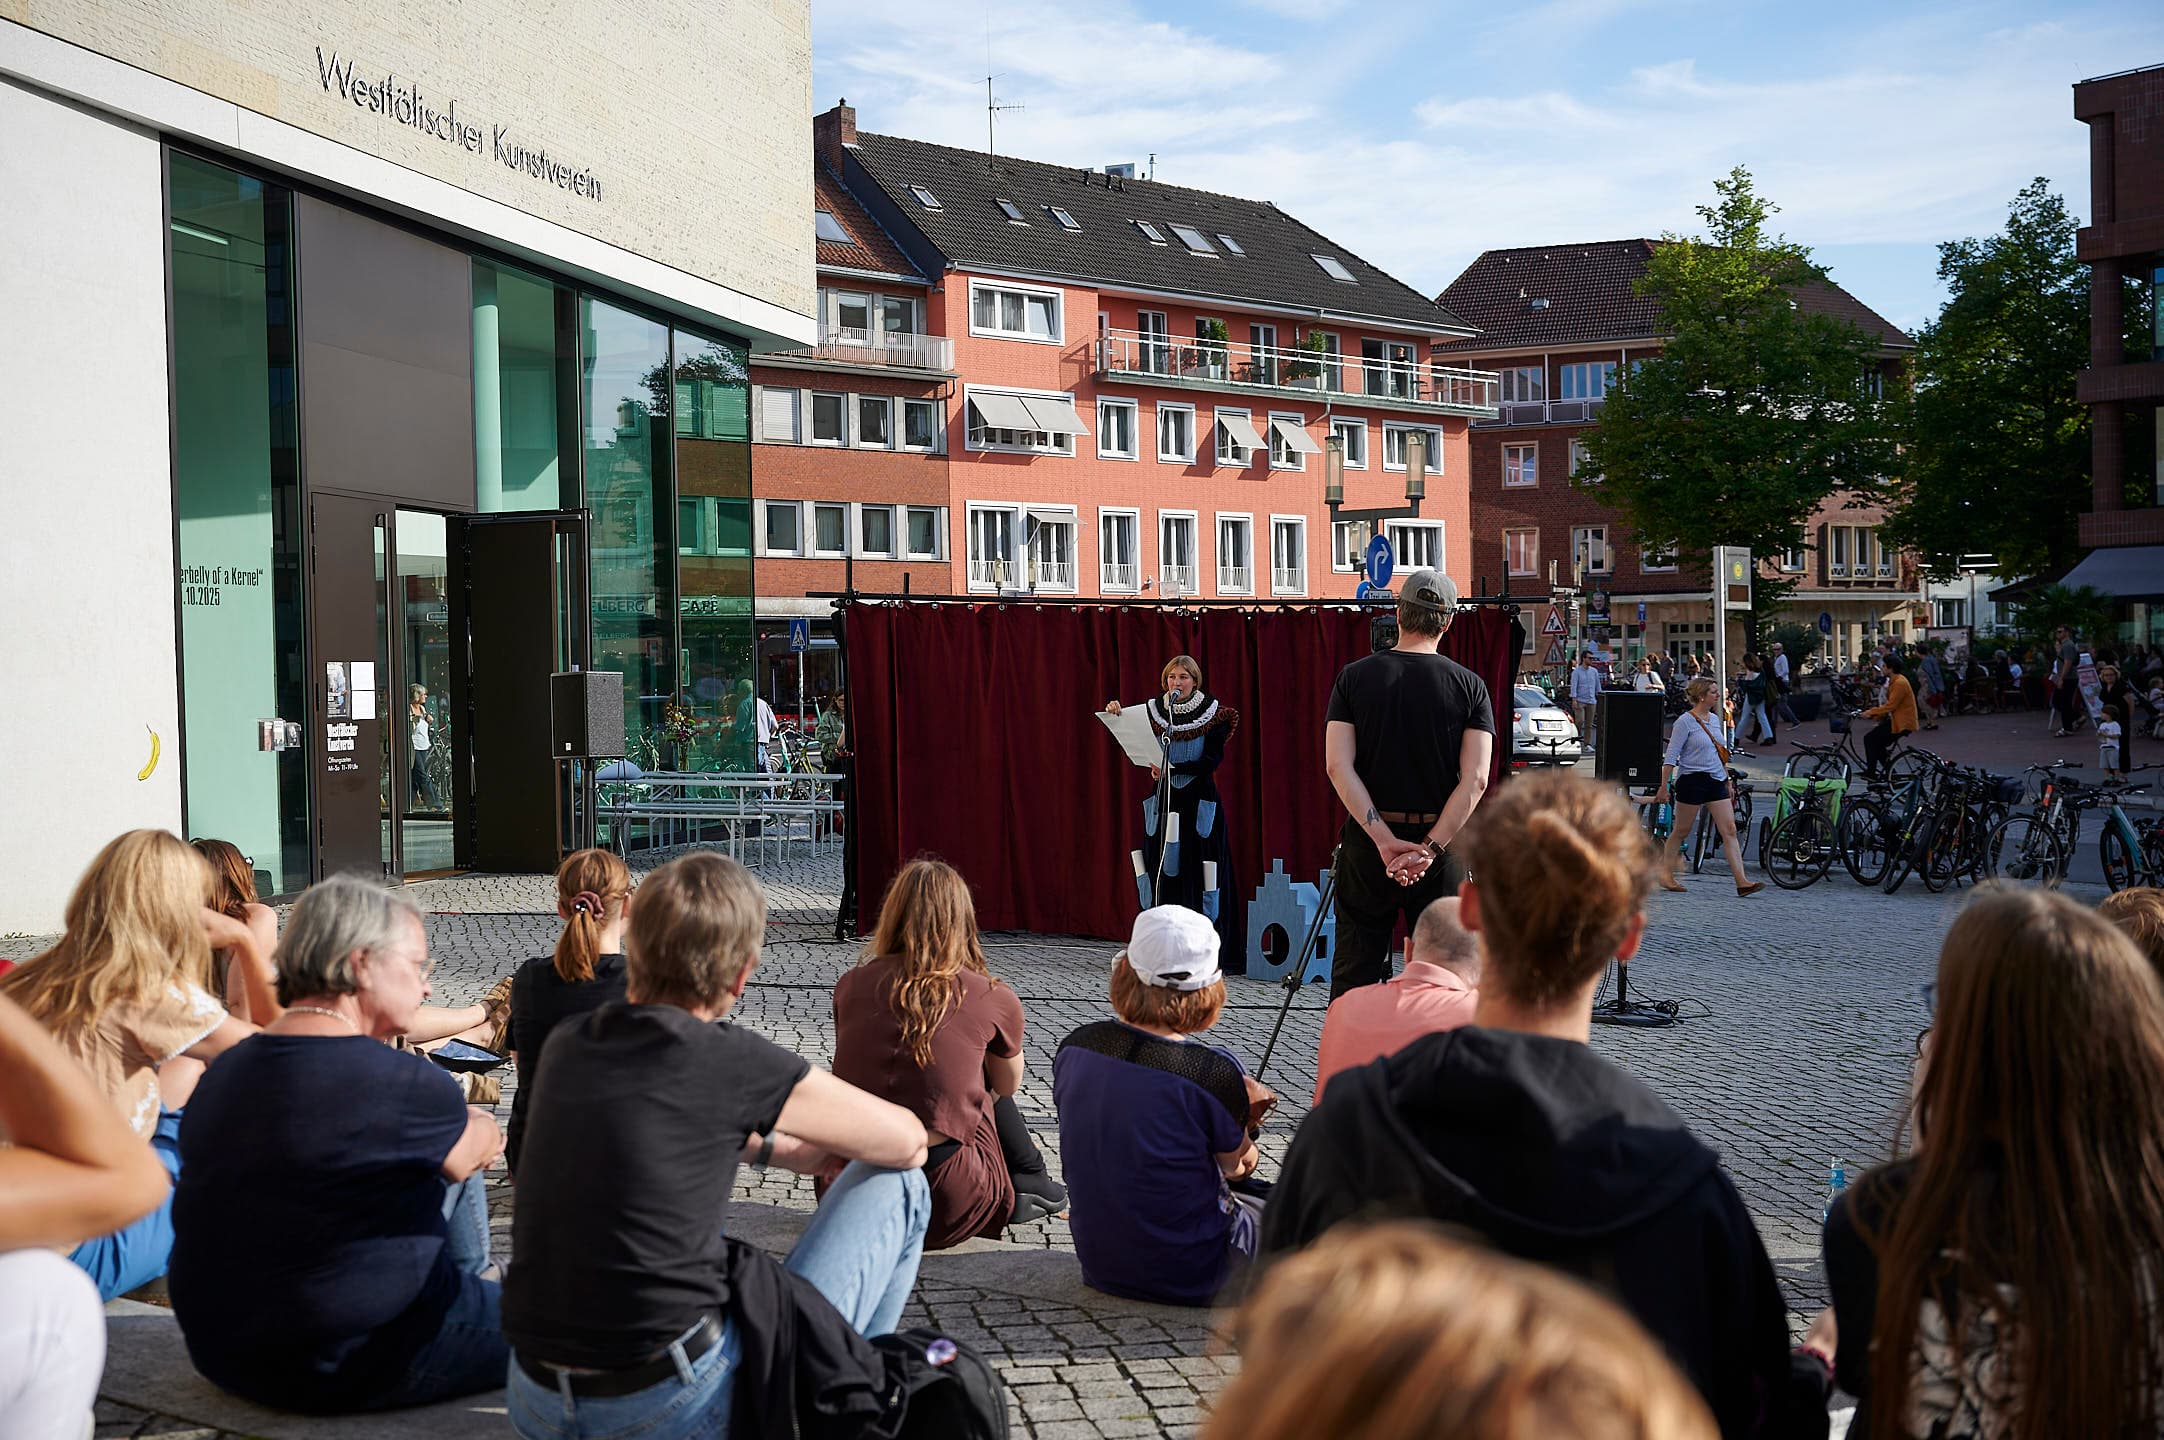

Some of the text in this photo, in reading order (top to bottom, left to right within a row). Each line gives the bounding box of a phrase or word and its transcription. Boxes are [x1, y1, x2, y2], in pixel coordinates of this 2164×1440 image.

[493, 123, 602, 203] Kunstverein
[212, 566, 221, 585] of
[224, 569, 229, 585] a
